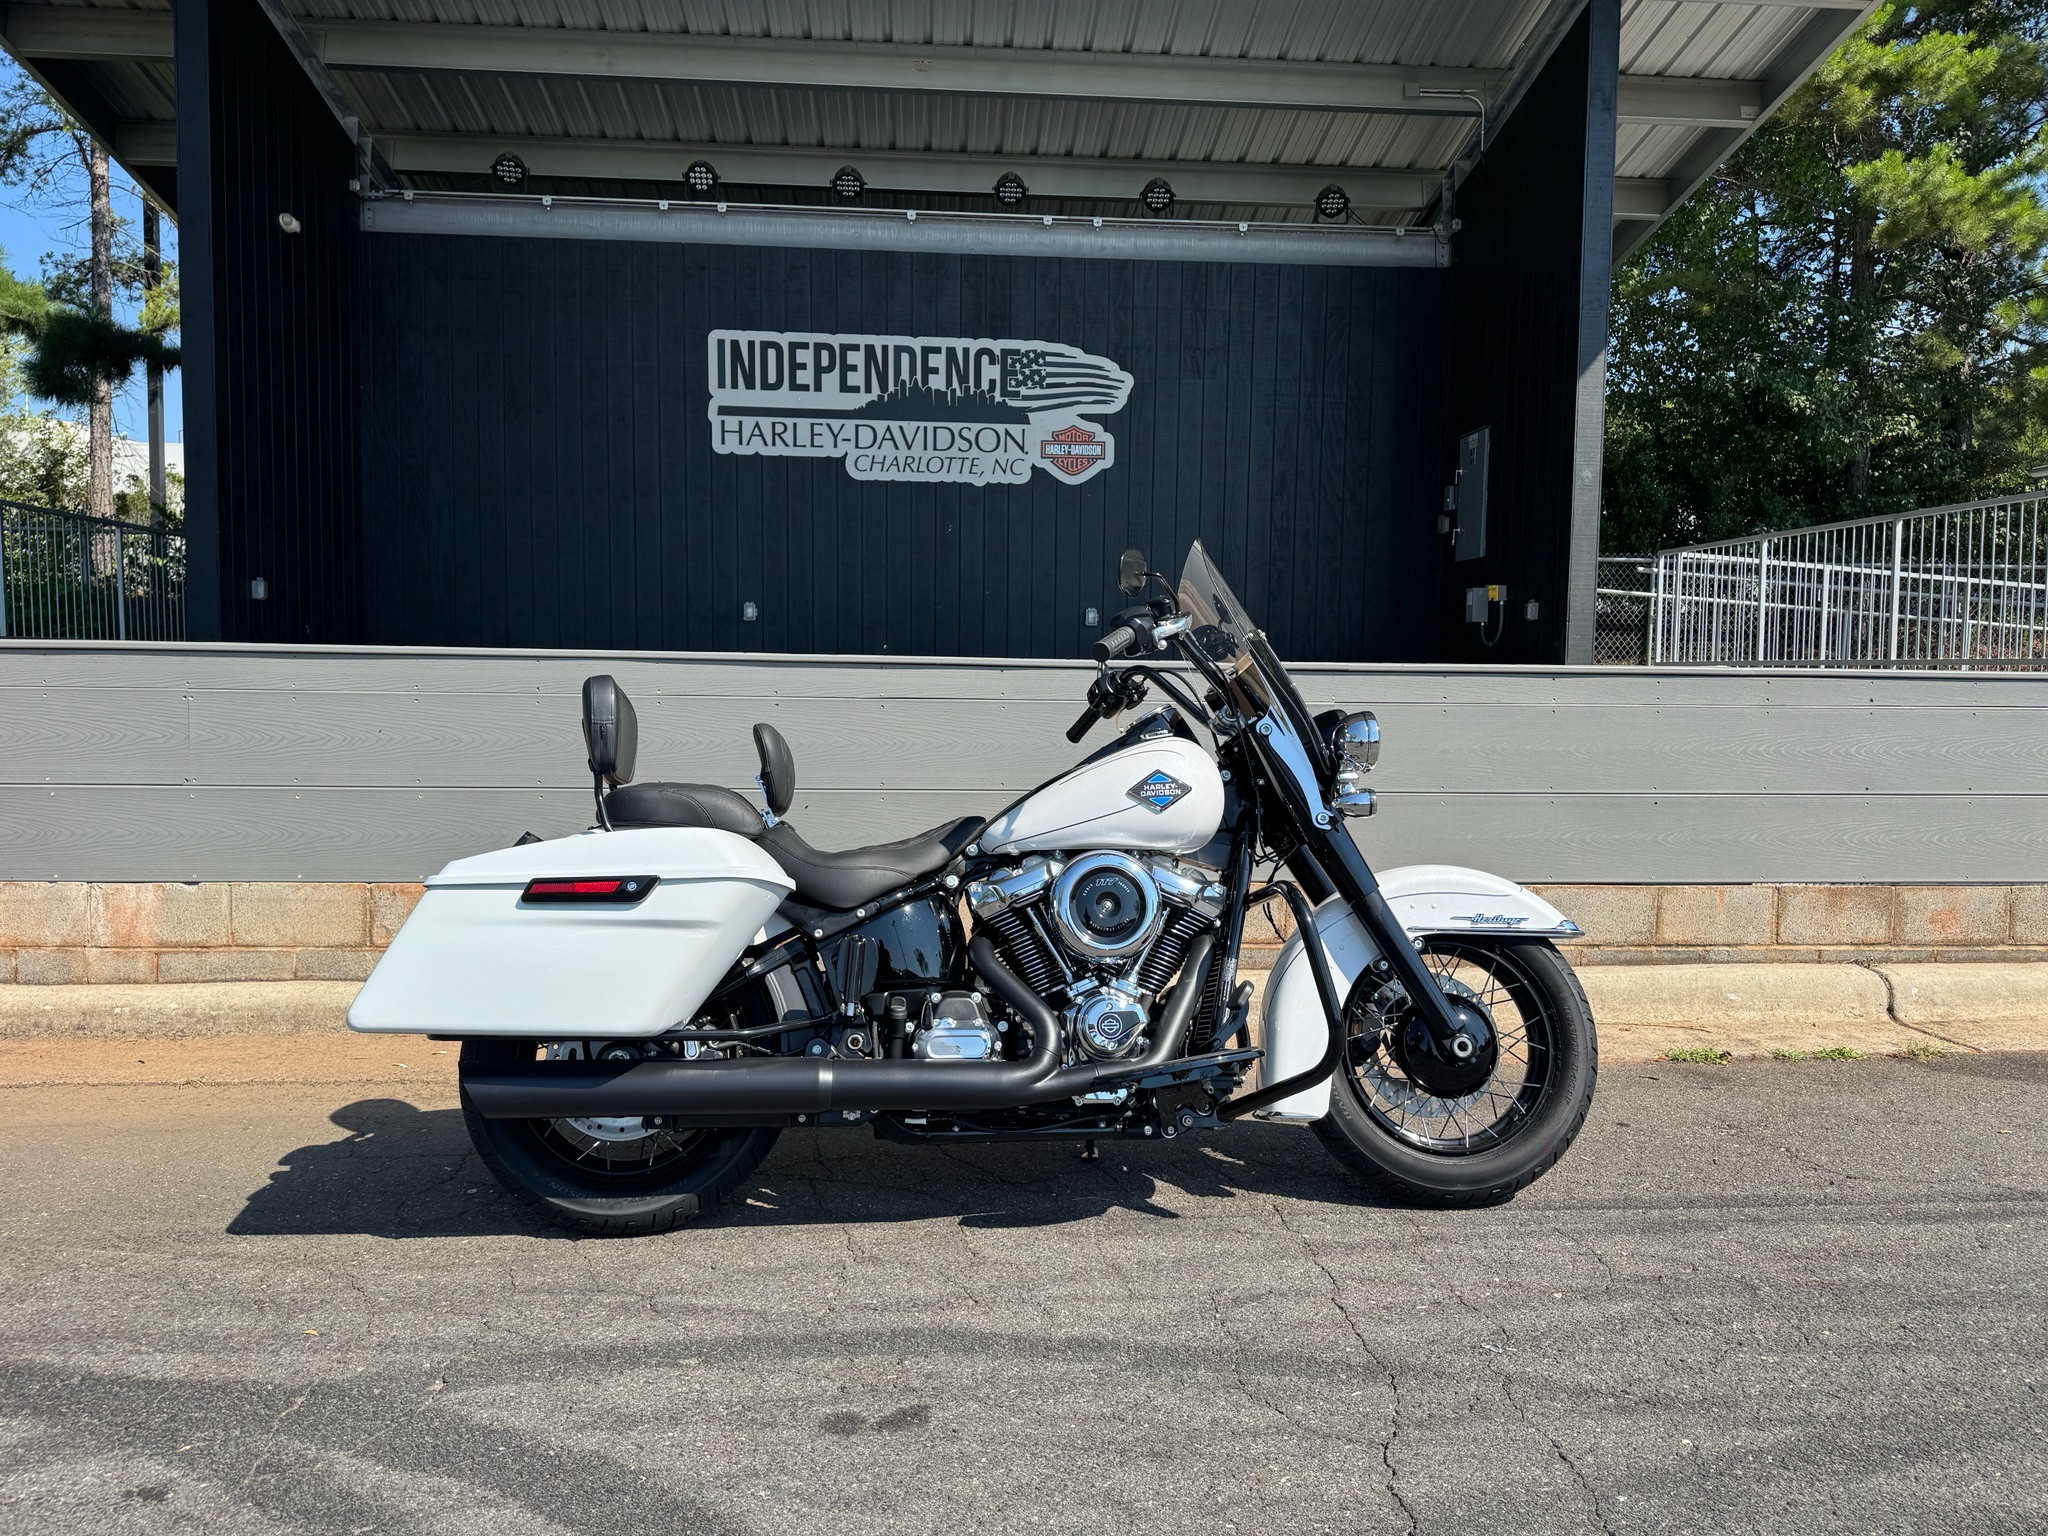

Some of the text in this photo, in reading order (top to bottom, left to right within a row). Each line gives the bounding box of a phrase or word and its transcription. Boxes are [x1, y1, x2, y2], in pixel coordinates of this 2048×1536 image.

[717, 338, 1021, 398] INDEPENDENCE
[1059, 429, 1088, 441] MOTOR
[1045, 444, 1102, 456] HARLEY-DAVIDSON
[854, 454, 1025, 478] CHARLOTTE, NC
[1058, 458, 1088, 471] CYCLES
[1140, 789, 1181, 797] DAVIDSON
